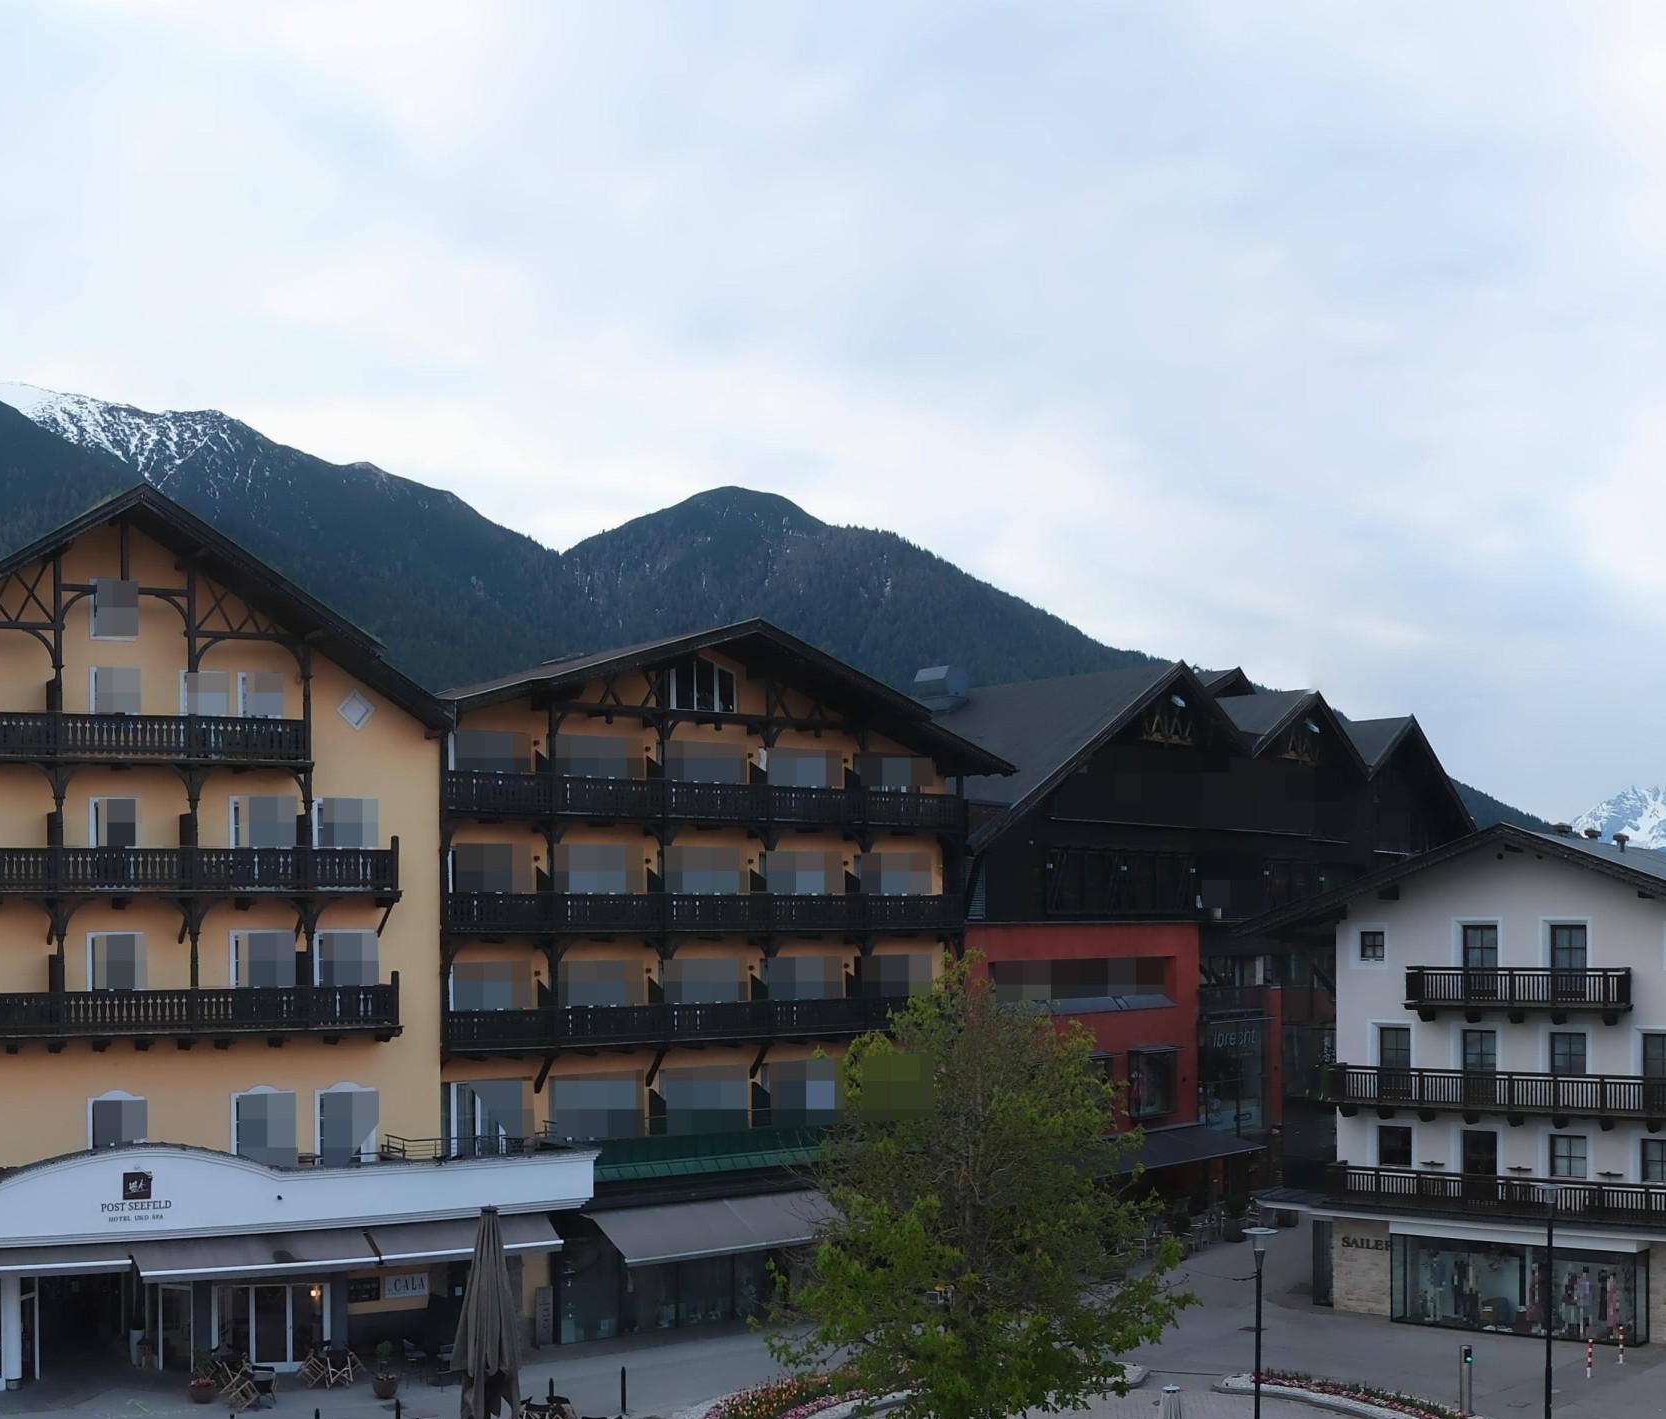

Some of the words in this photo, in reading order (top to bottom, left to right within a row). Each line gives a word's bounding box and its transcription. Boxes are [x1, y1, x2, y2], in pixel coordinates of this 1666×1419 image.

[100, 1202, 126, 1212] POST
[128, 1200, 172, 1211] SEEFELD
[394, 1277, 425, 1292] CALA
